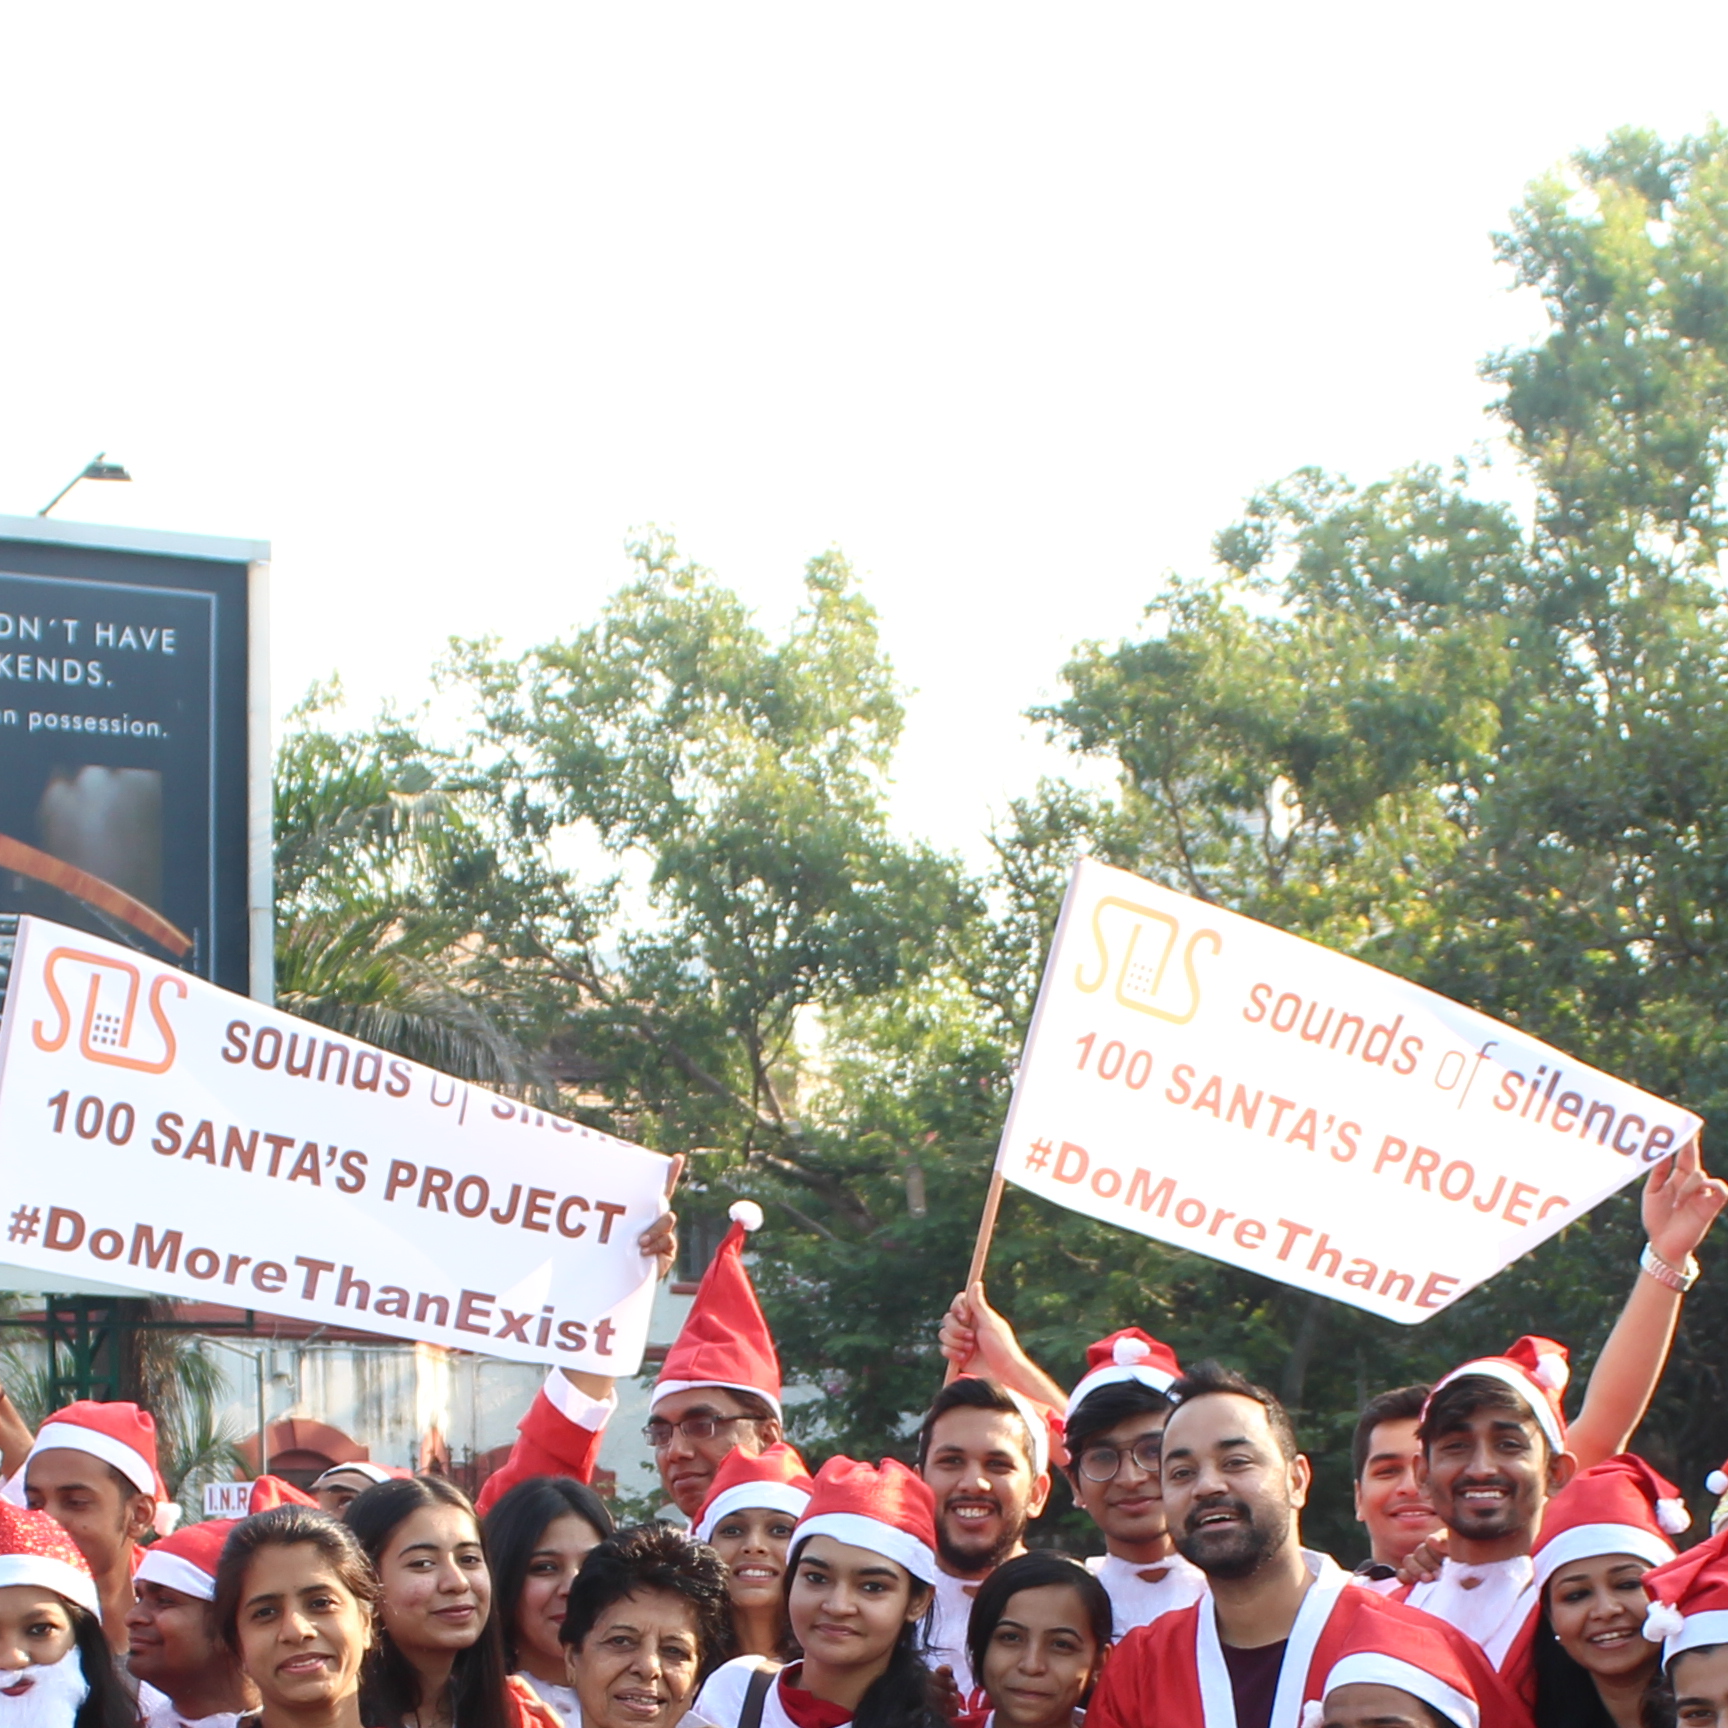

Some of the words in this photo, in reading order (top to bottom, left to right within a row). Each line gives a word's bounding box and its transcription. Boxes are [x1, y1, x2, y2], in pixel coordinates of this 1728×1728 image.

[95, 621, 177, 655] HAVE
[29, 712, 168, 738] possession.
[1075, 1032, 1153, 1091] 100
[1164, 1063, 1362, 1162] SANTA'S
[1242, 982, 1424, 1075] sounds
[1435, 1041, 1500, 1110] of
[1493, 1064, 1676, 1163] silence
[47, 1088, 136, 1146] 100
[151, 1110, 368, 1194] SANTA'S
[383, 1159, 627, 1245] PROJECT
[7, 1203, 617, 1357] #DoMoreThanExist
